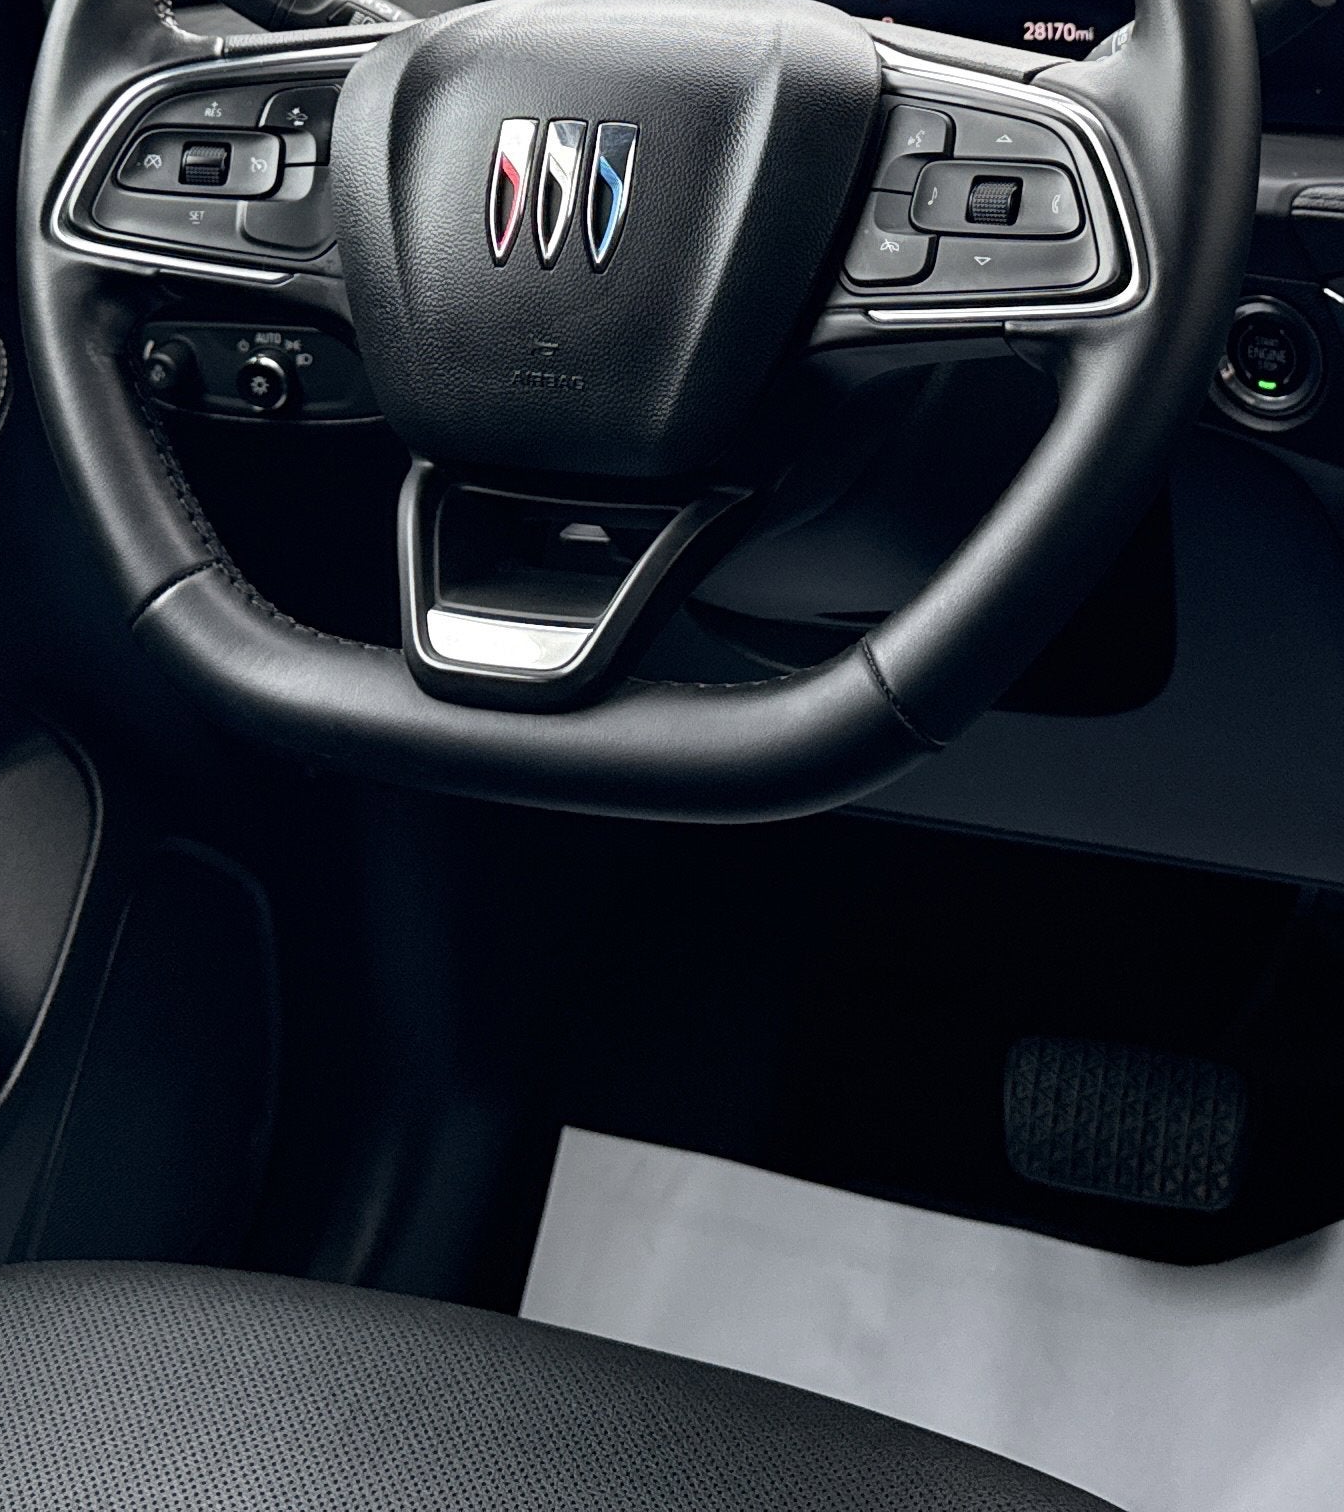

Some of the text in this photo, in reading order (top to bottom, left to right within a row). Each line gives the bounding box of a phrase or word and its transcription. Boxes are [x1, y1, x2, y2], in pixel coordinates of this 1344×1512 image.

[205, 108, 223, 118] RES
[189, 210, 204, 221] SET
[256, 332, 282, 345] AUTO
